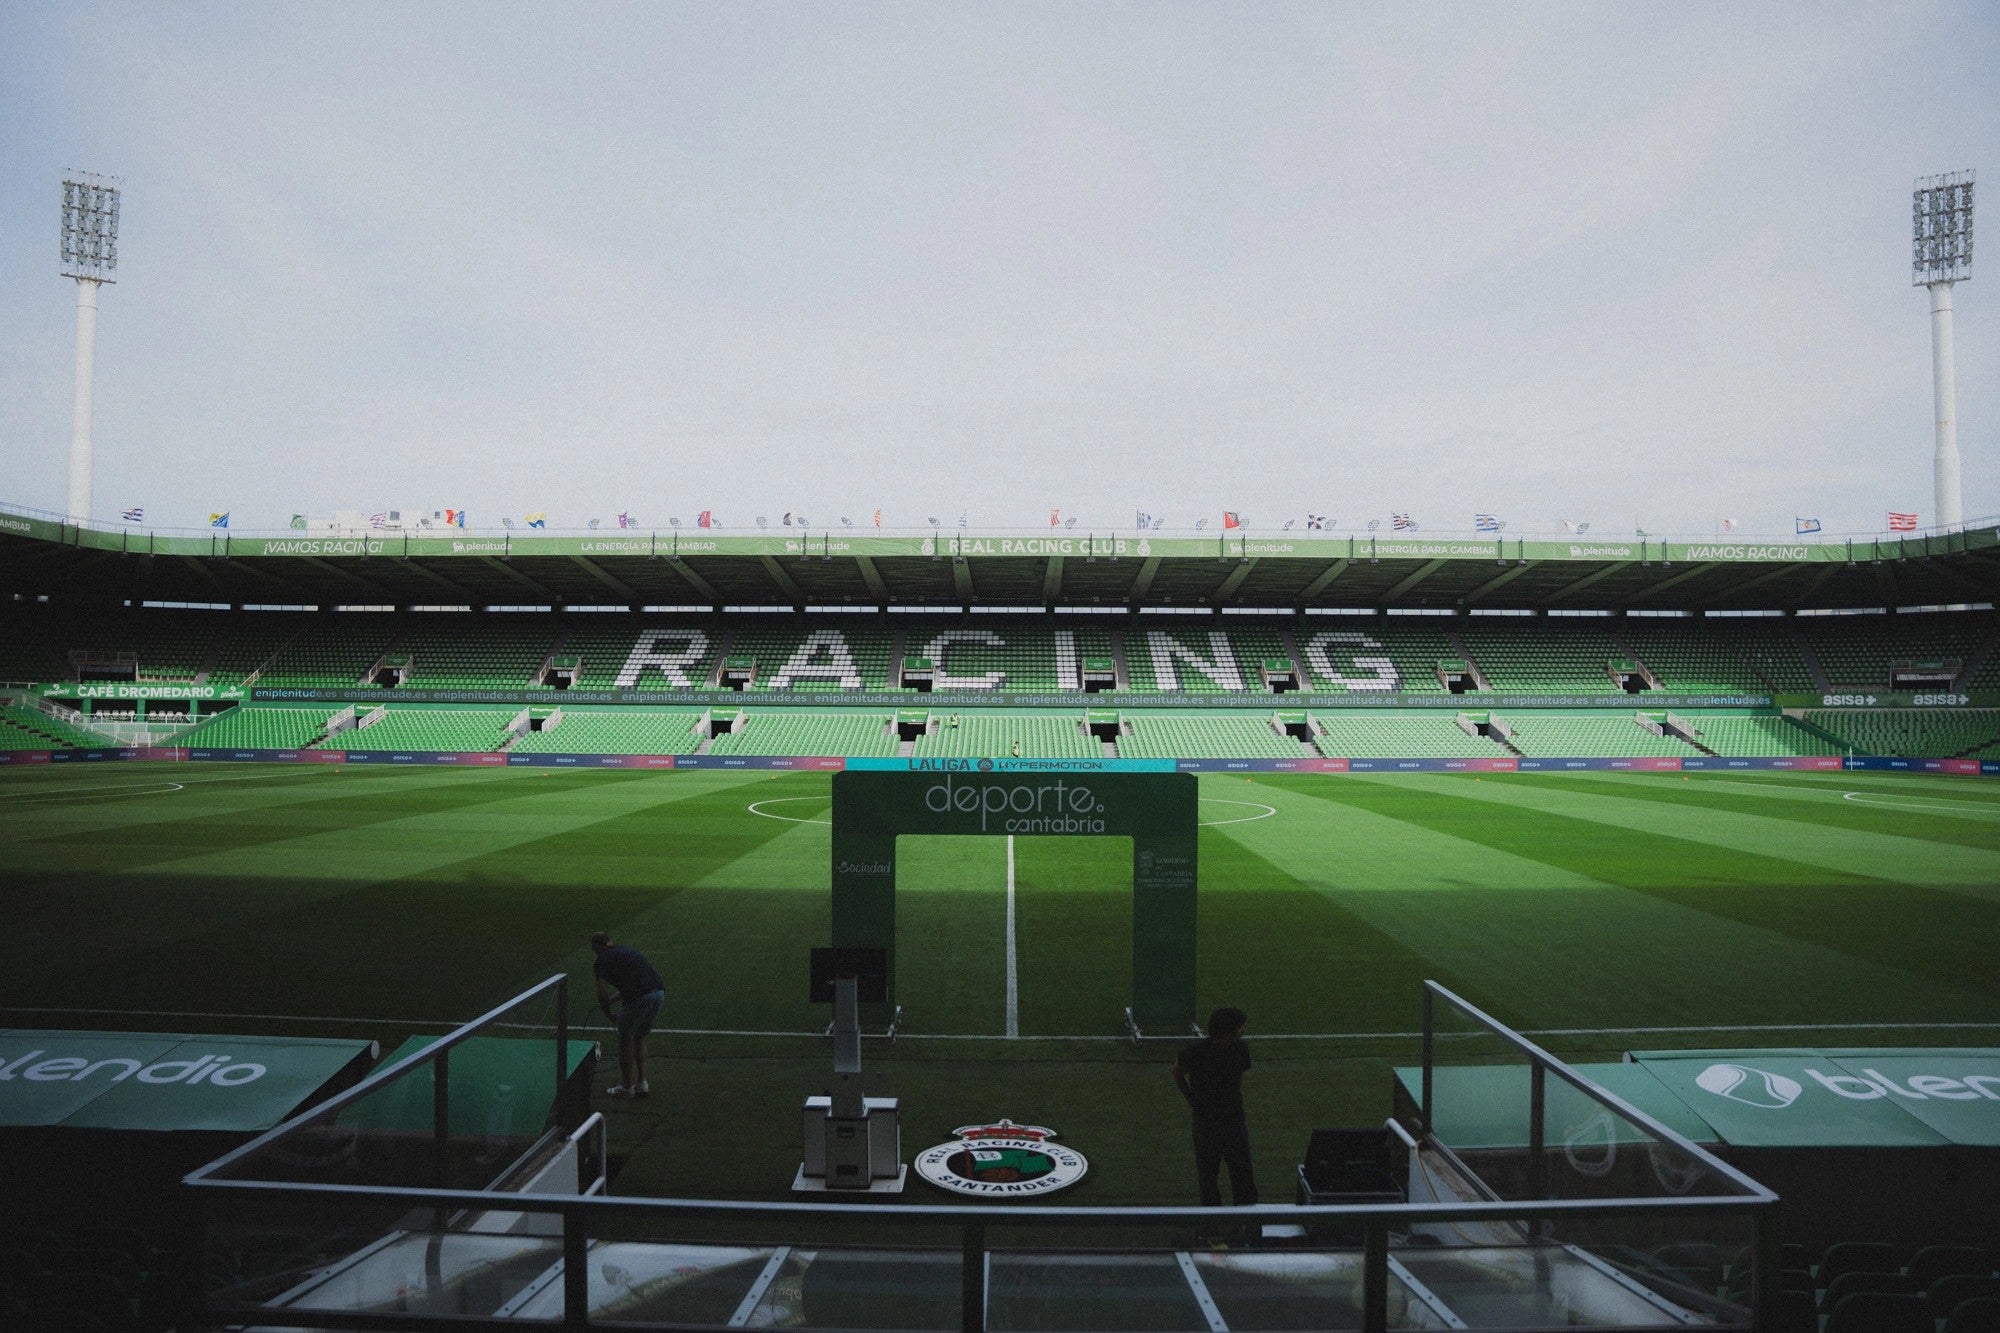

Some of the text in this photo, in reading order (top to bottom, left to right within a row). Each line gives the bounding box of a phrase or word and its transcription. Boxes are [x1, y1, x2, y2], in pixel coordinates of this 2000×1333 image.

[264, 541, 384, 555] ¡VAMOS RACING!
[467, 543, 512, 552] plenitude
[581, 541, 717, 551] LA ENERGÍA PARA CAMBIAR
[801, 542, 849, 552] plenitude
[949, 540, 1127, 553] REAL RACING CLUB
[1245, 543, 1293, 553] plenitude
[1360, 543, 1496, 554] LA ENERGÍA PARA CAMBIAR
[1584, 546, 1630, 555] plenitude
[1686, 546, 1808, 560] ¡VAMOS RACING!
[614, 629, 1401, 690] RACING
[77, 684, 115, 697] CAFÉ
[119, 687, 215, 697] DROMEDARIO
[256, 690, 337, 698] eniplenitude.es
[344, 690, 427, 699] eniplenitude.es
[434, 691, 518, 700] eniplenitude.es
[526, 691, 612, 701] eniplenitude.es
[622, 692, 710, 701] eniplenitude.es
[718, 692, 807, 703] eniplenitude.es
[815, 694, 904, 703] eniplenitude.es
[913, 694, 1004, 704] eniplenitude.es
[1014, 696, 1105, 705] eniplenitude.es
[1113, 696, 1204, 705] eniplenitude.es
[1212, 696, 1301, 705] eniplenitude.es
[1310, 696, 1398, 706] eniplenitude.es
[1408, 696, 1495, 706] eniplenitude.es
[1503, 696, 1588, 706] eniplenitude.es
[1595, 696, 1680, 706] eniplenitude.es
[1688, 696, 1771, 706] eniplenitude.es
[1823, 694, 1957, 706] asisa asisa
[908, 758, 971, 771] LALIGA
[1005, 813, 1105, 833] cantabria
[0, 1050, 267, 1086] lendio
[927, 1146, 957, 1164] REAL
[961, 1140, 1042, 1149] RACING
[1046, 1148, 1078, 1167] CLUB
[938, 1174, 1063, 1192] SANTANDER
